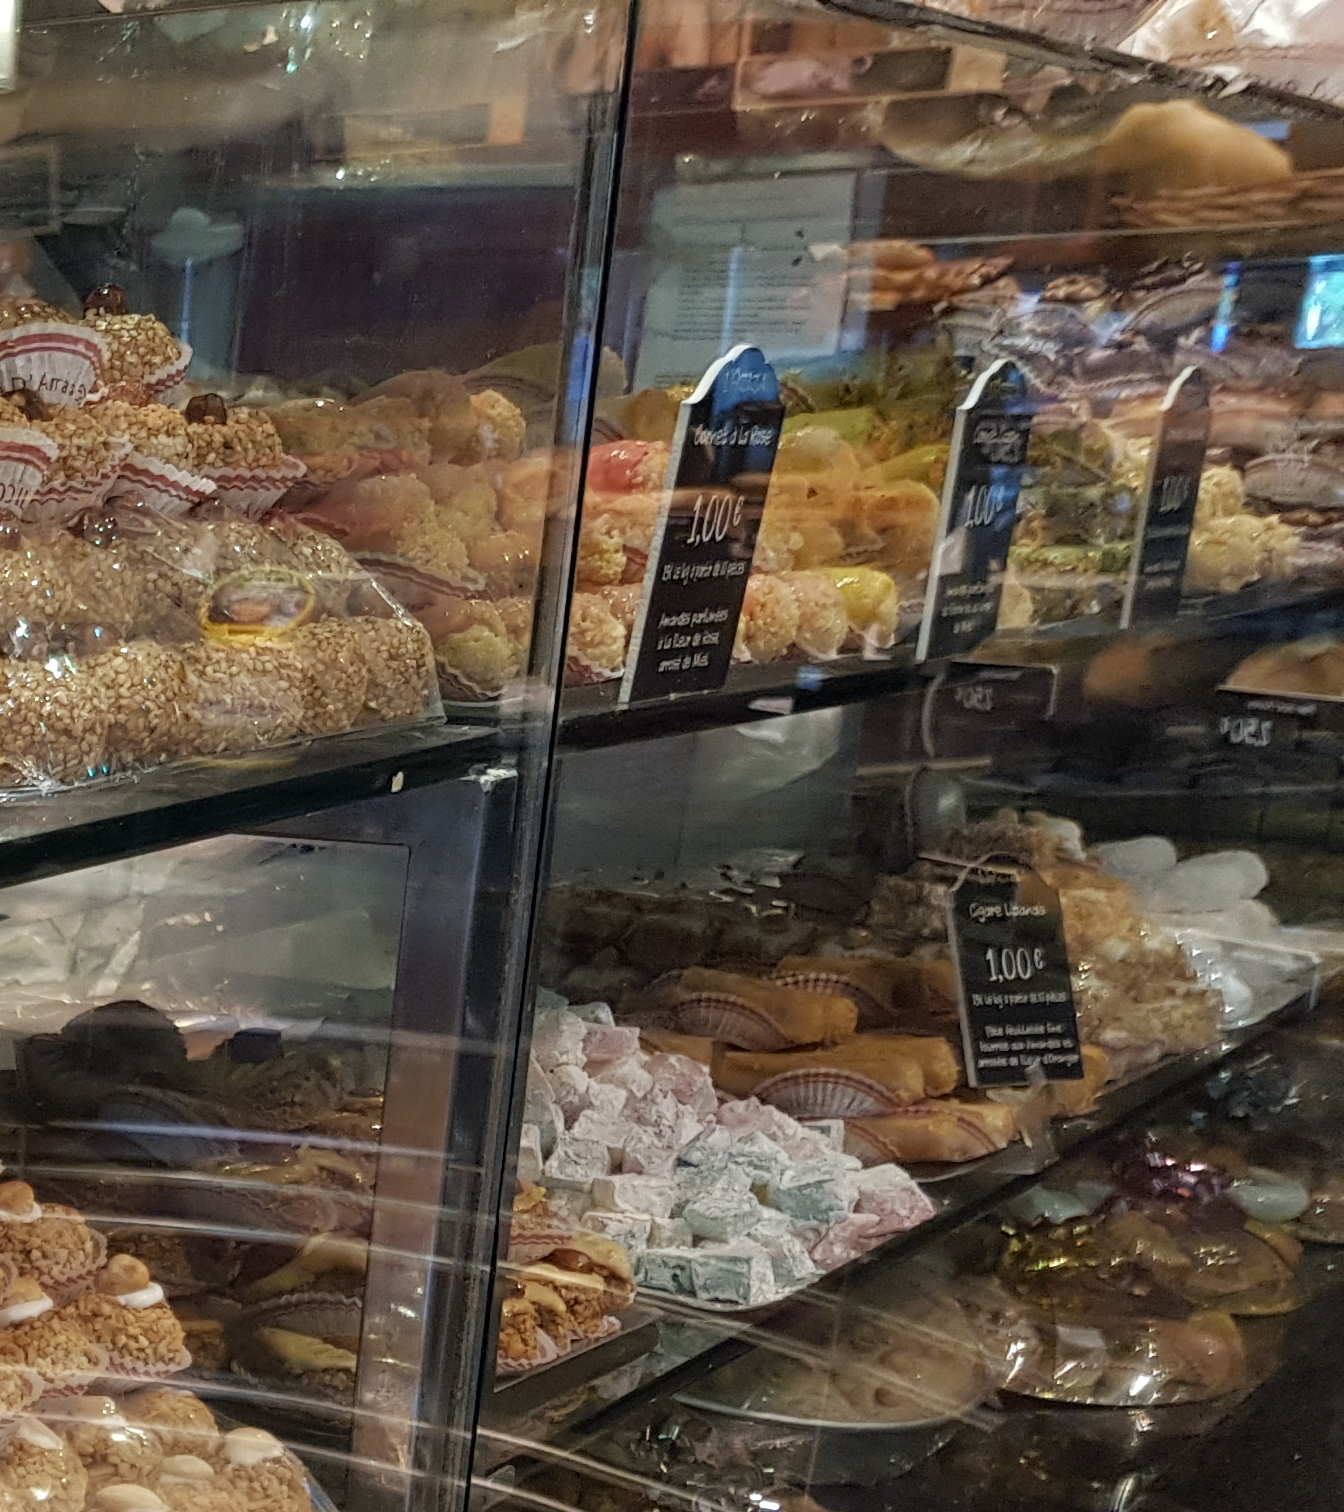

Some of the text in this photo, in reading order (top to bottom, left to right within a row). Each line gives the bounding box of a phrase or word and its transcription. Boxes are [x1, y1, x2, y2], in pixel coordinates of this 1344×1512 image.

[687, 494, 732, 549] 1,00
[985, 947, 1045, 983] 1,00 €
